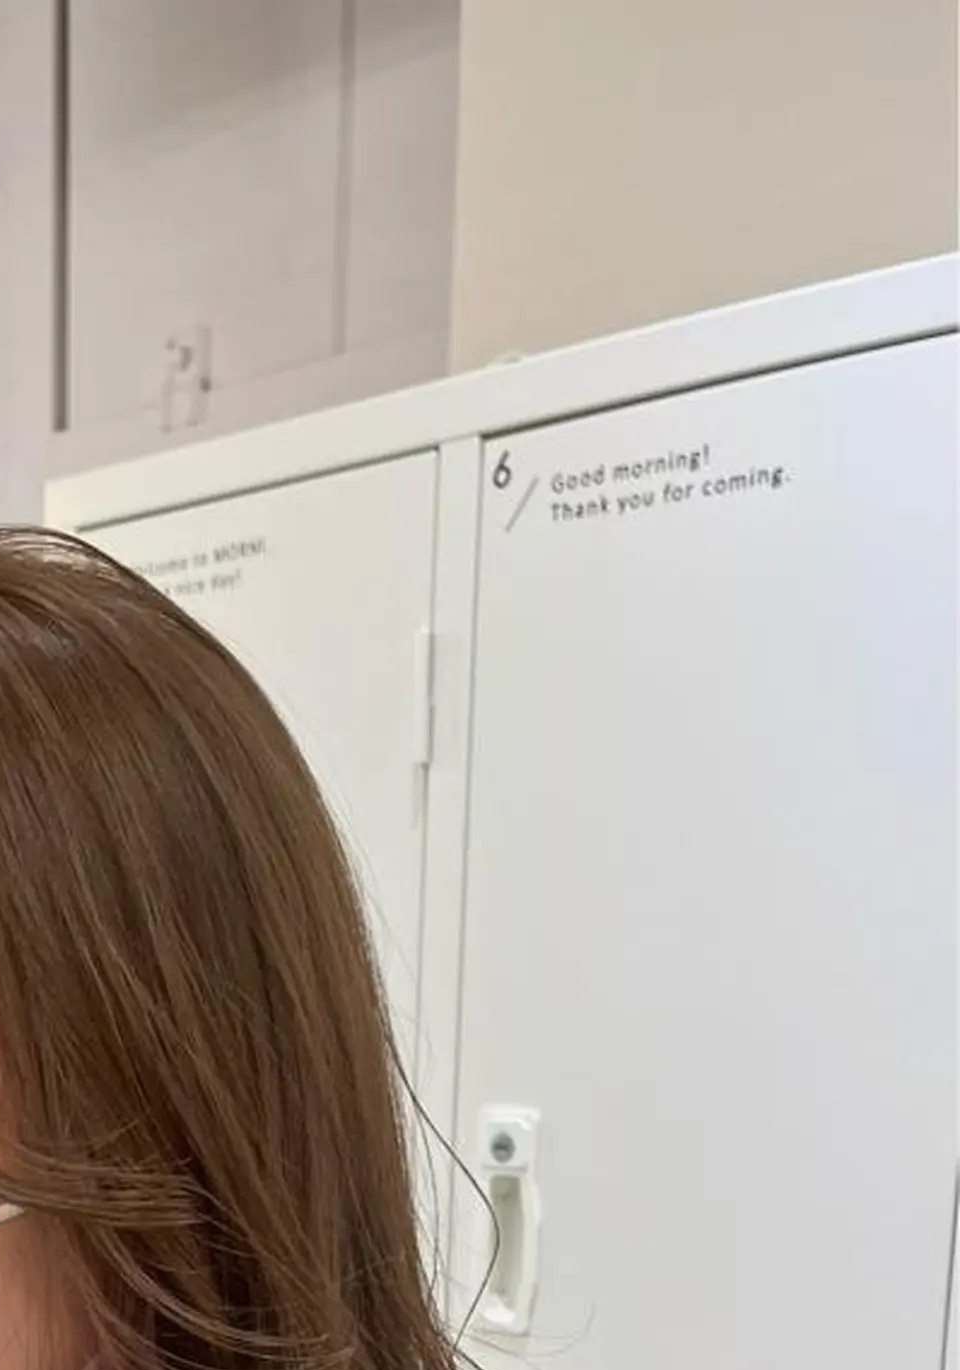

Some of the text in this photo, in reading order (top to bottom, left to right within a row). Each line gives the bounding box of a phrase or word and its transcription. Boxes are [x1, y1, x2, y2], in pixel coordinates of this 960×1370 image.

[491, 449, 513, 490] 6
[550, 443, 711, 495] Good morning!
[550, 464, 793, 522] Thank you for coming.
